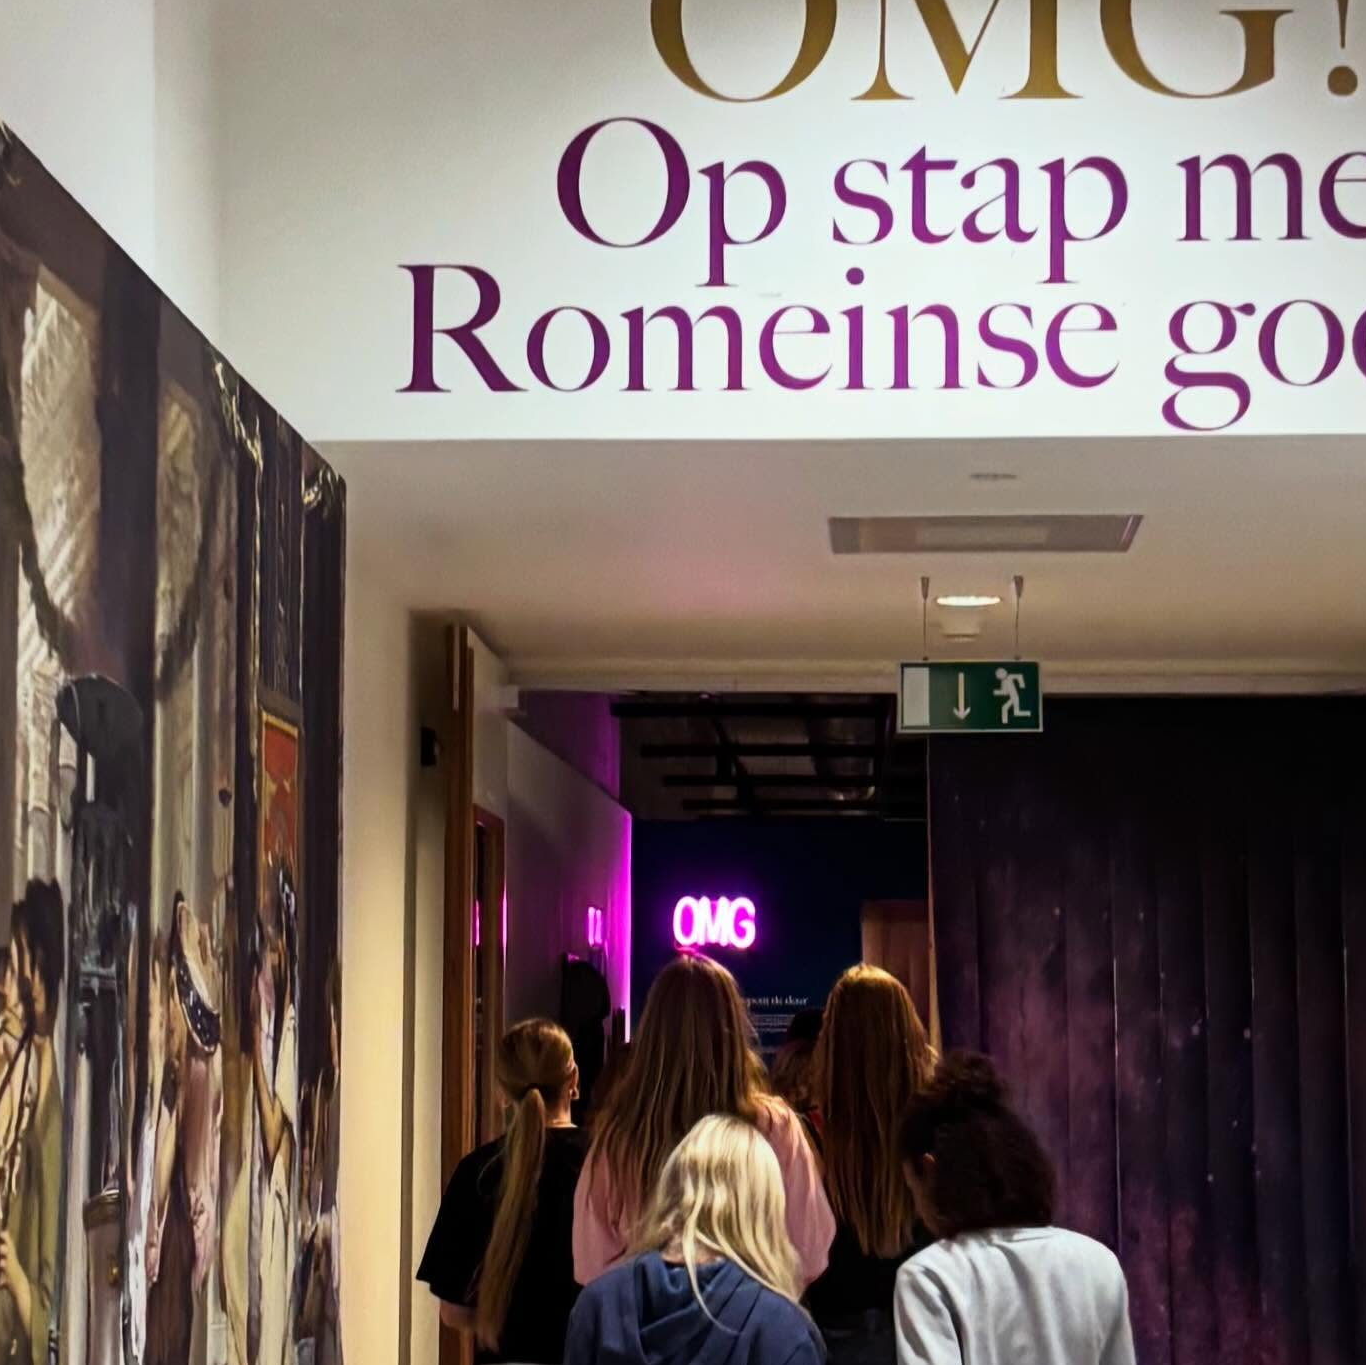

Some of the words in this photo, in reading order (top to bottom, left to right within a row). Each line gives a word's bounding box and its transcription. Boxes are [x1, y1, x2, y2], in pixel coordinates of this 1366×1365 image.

[556, 116, 787, 288] Op
[833, 144, 1129, 285] stap
[394, 263, 1120, 394] Romeinse
[673, 895, 756, 948] OMG
